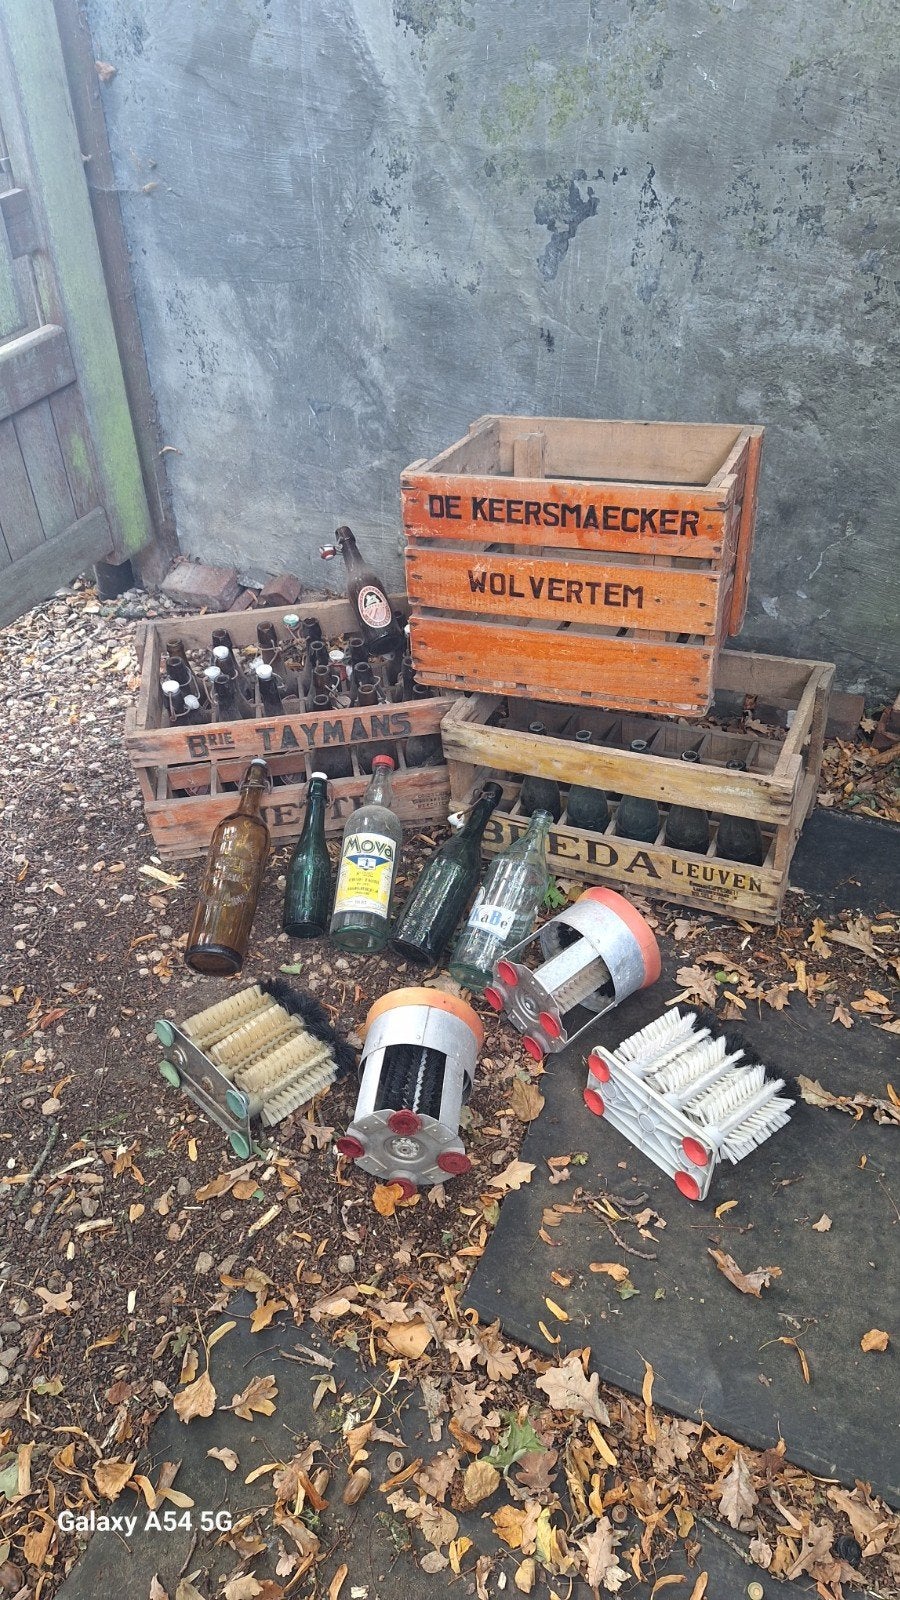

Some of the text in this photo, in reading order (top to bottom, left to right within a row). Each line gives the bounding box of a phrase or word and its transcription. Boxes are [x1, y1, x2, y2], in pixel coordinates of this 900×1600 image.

[428, 494, 701, 537] DE KEERSMAECKER
[467, 569, 645, 609] WOLVERTEM
[255, 712, 412, 751] TAYMANS
[671, 860, 762, 893] LEUVEN
